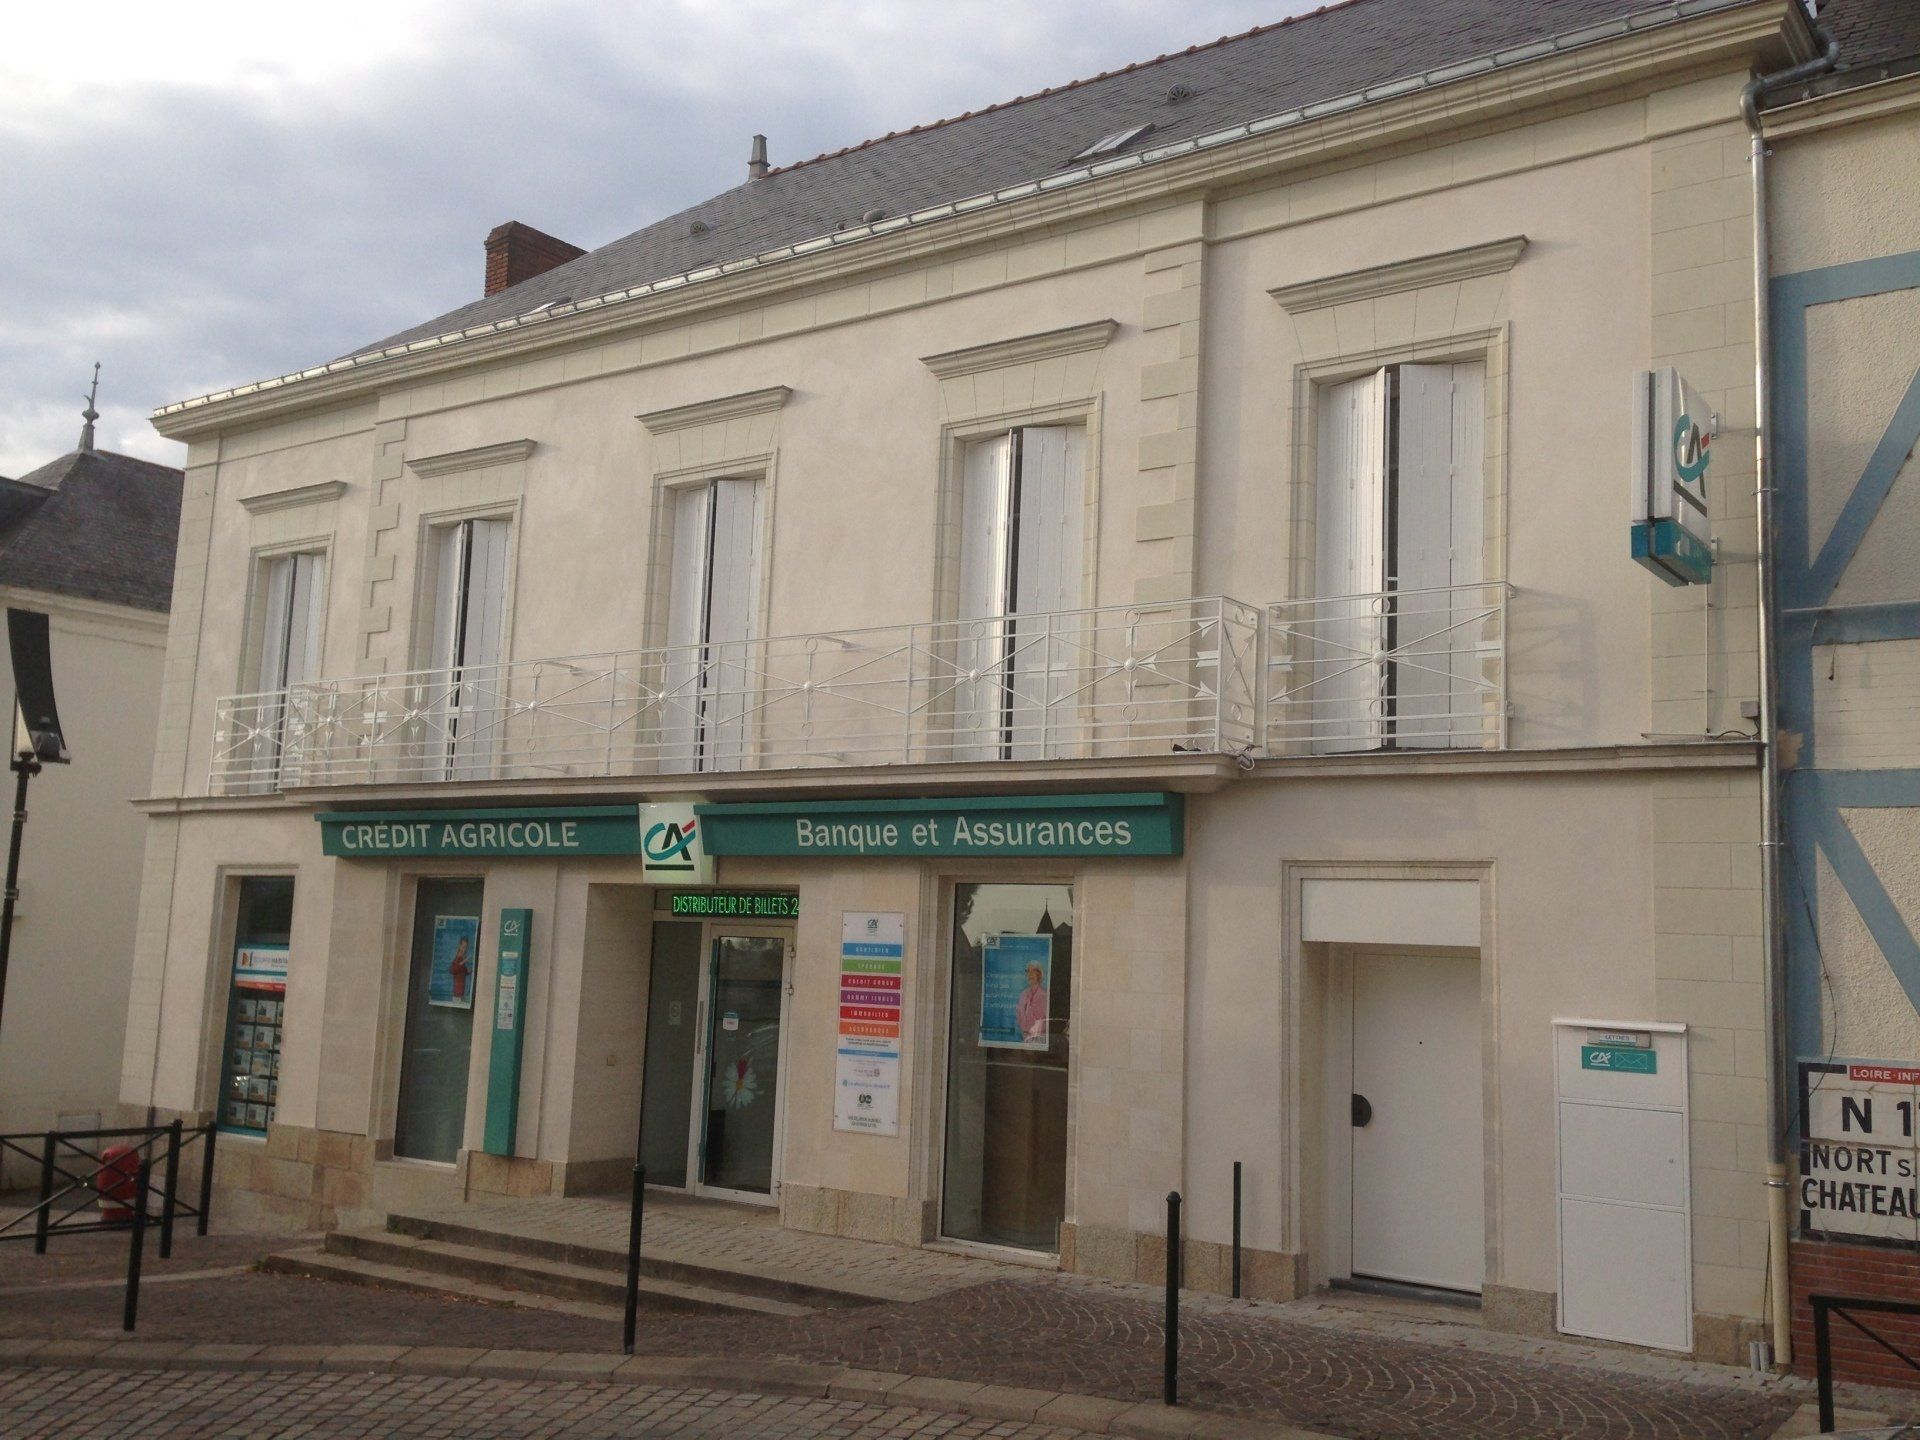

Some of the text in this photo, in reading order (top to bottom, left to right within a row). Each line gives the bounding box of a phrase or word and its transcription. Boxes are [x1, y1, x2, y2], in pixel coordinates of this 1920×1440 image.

[441, 821, 580, 848] AGRICOLE
[796, 816, 1132, 853] Banque et Assurances
[673, 896, 737, 914] DISTRIBUTEUR
[739, 896, 752, 914] DE
[754, 897, 788, 915] BILLETS
[1842, 1096, 1920, 1137] N 1
[1812, 1144, 1892, 1175] NORT
